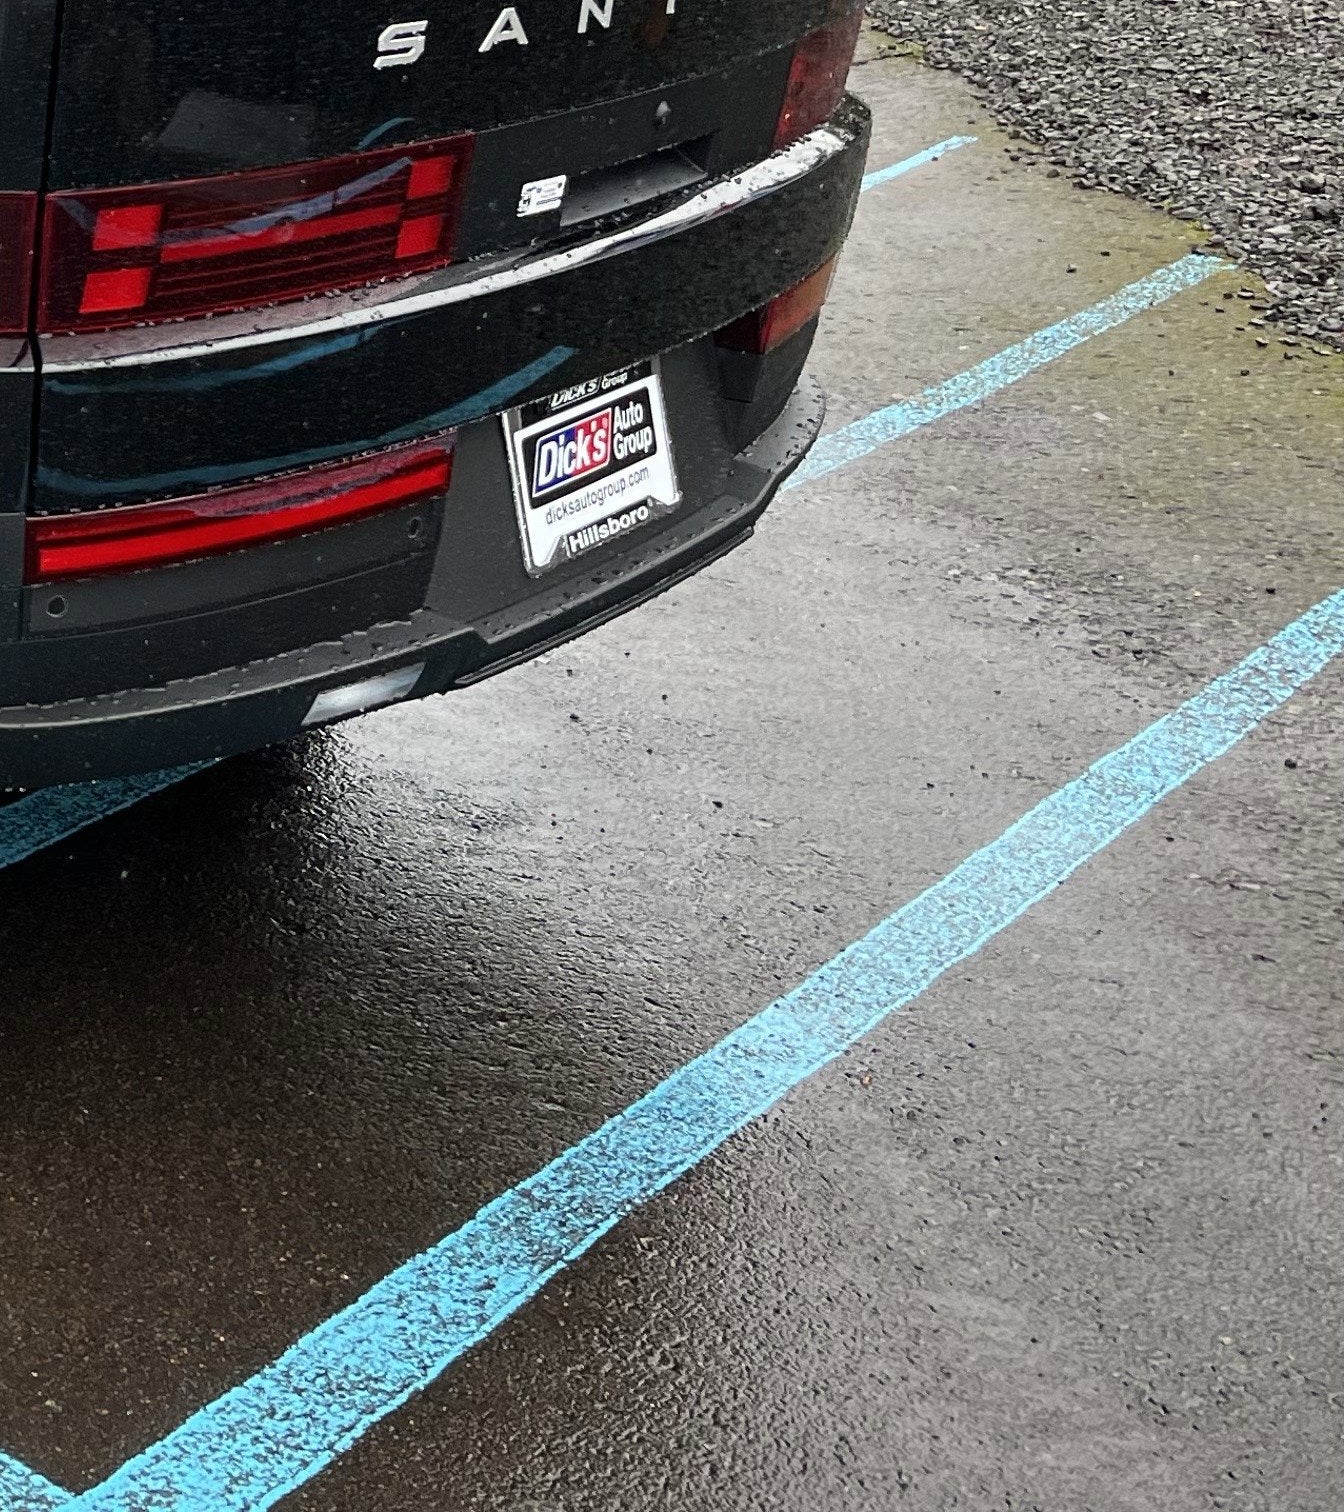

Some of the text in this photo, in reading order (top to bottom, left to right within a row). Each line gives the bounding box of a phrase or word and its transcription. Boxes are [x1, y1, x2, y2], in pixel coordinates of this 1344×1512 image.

[538, 400, 644, 487] Dick's Auto
[614, 426, 653, 460] Group
[546, 466, 650, 525] dicksautogroup.com
[568, 505, 650, 553] Hillsboro
